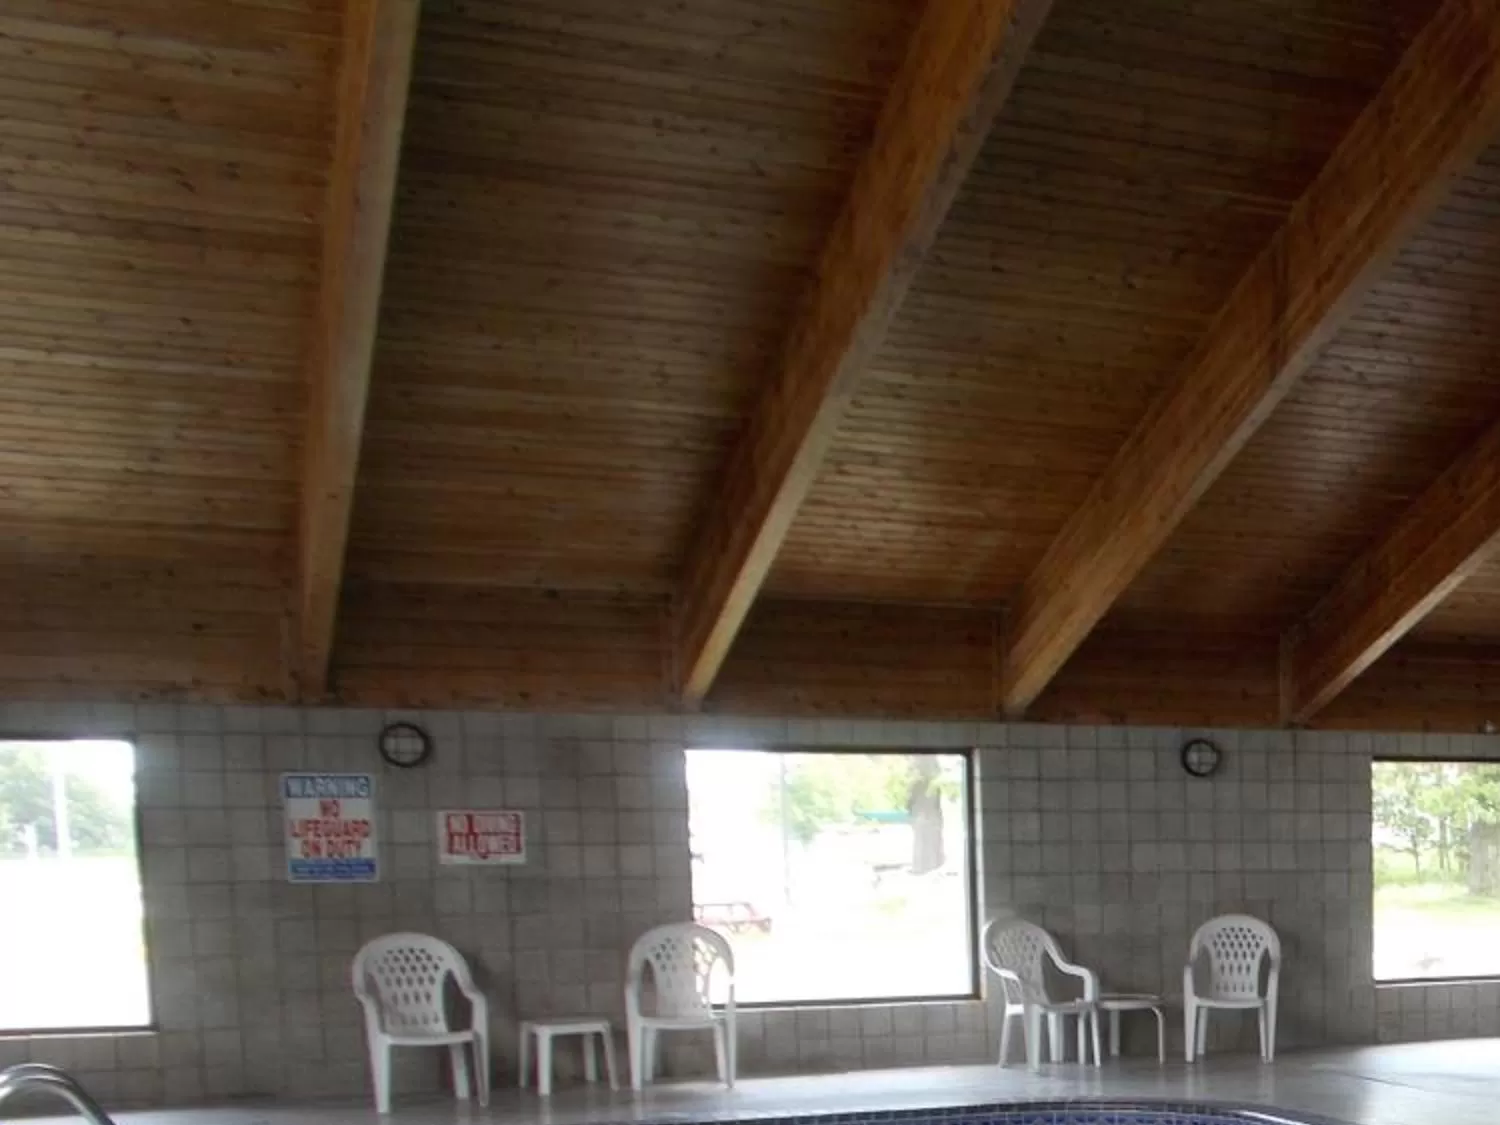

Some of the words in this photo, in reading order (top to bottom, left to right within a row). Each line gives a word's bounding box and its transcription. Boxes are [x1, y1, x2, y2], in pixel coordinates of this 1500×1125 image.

[288, 778, 369, 797] WARNING
[319, 800, 340, 818] NO
[291, 819, 370, 838] LIFEGUARD
[301, 839, 322, 858] ON
[326, 839, 361, 858] DUTY
